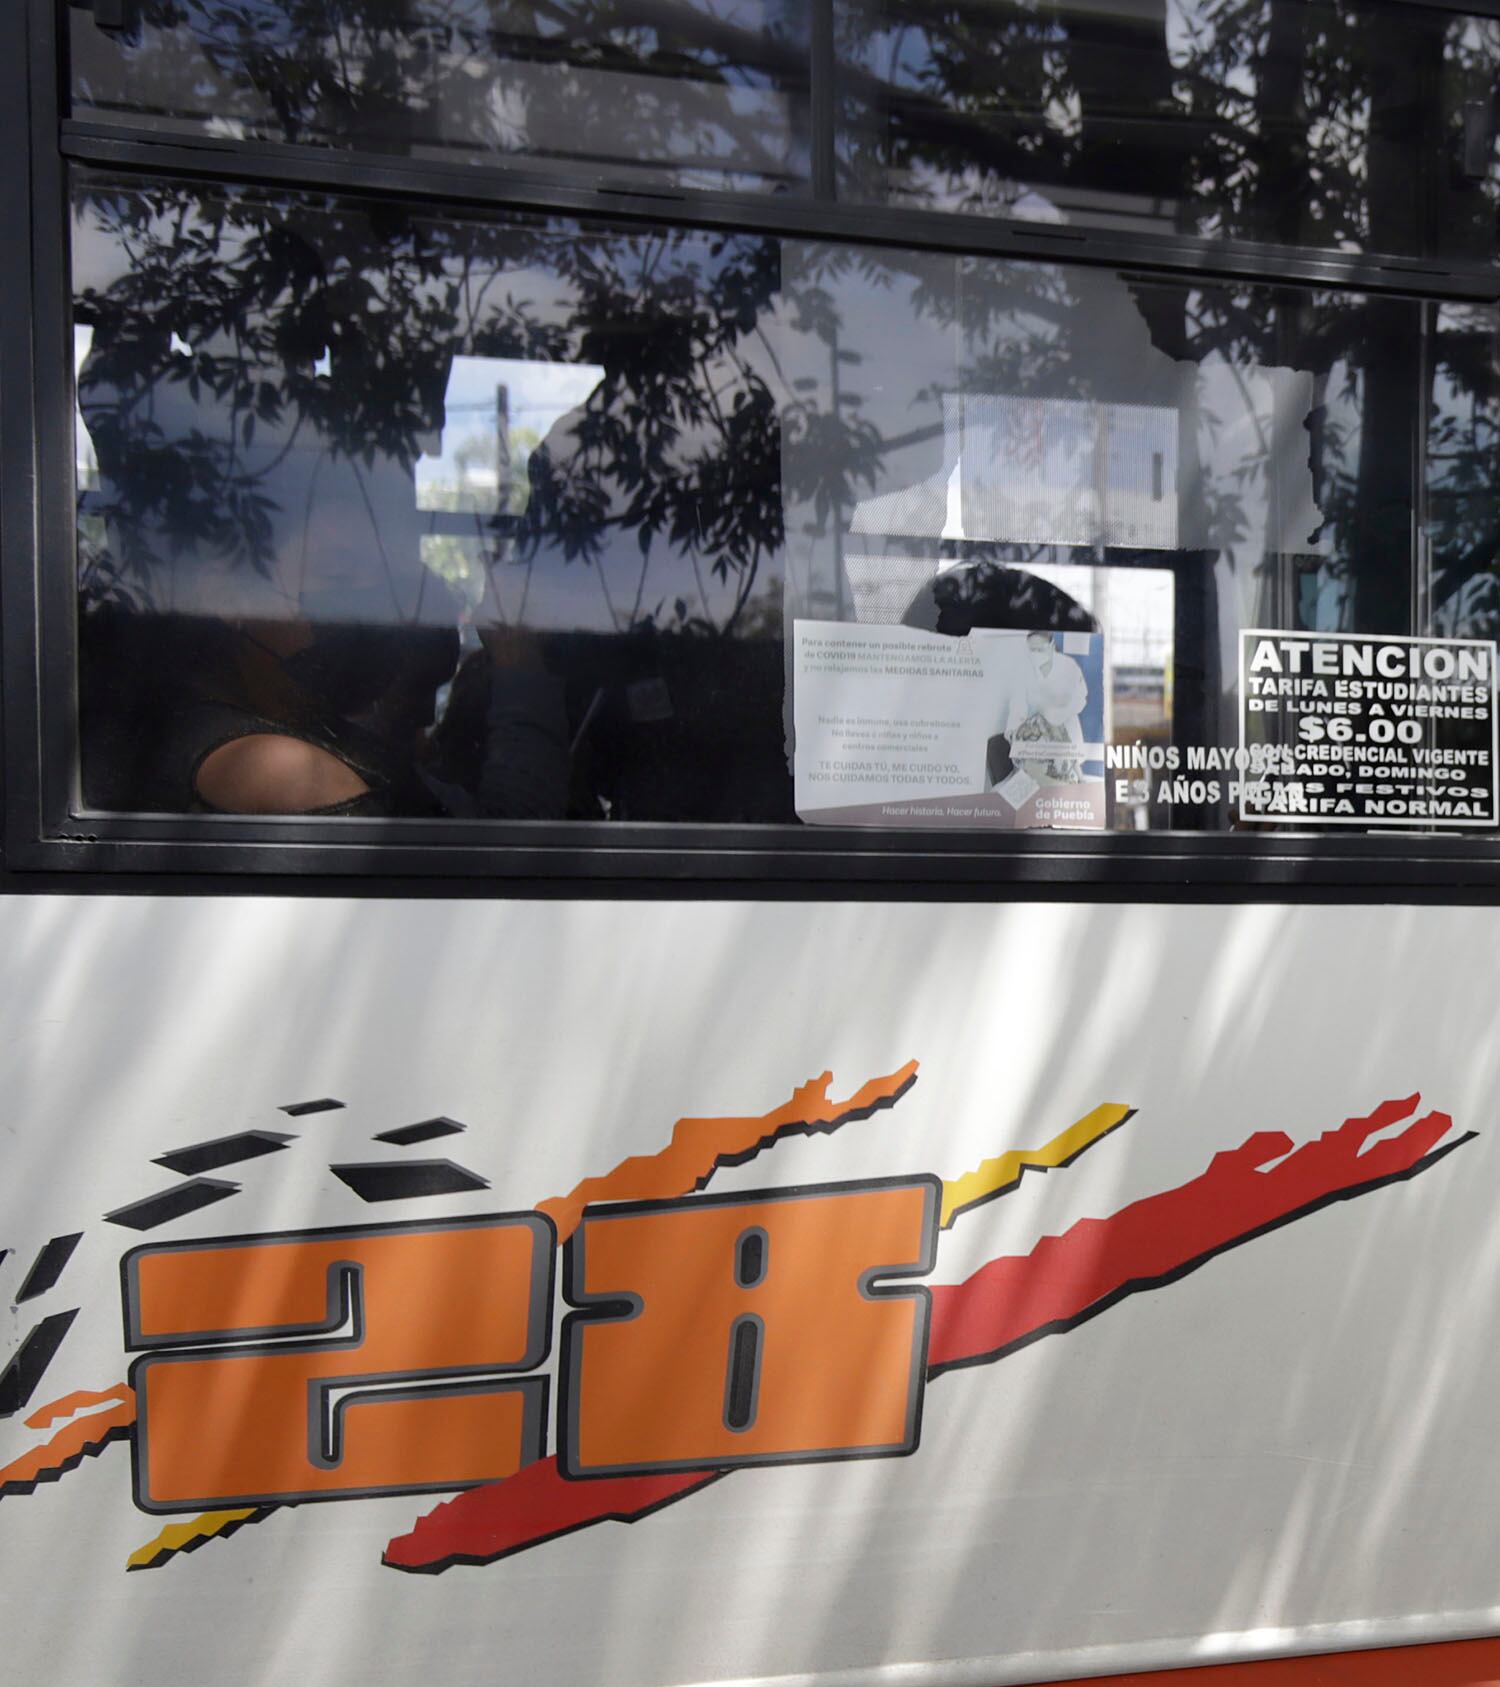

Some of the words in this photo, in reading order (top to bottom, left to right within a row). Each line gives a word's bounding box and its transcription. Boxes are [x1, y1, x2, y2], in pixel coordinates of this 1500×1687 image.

[882, 641, 916, 651] posible
[1250, 640, 1488, 681] ATENCION
[885, 666, 928, 676] MEDIDAS
[929, 668, 984, 678] SANITARIAS
[1249, 677, 1328, 697] TARIFA
[1335, 680, 1488, 703] ESTUDIANTES
[1248, 699, 1279, 712] DE
[1287, 701, 1362, 715] LUNES
[1369, 703, 1385, 716] A
[1391, 704, 1489, 719] VIERNES
[1298, 715, 1423, 744] $6.00
[1106, 740, 1180, 770] NIÑOS
[1294, 744, 1407, 764] CREDENCIAL
[1412, 749, 1489, 766] VIGENTE
[1359, 766, 1466, 781] DOMINGO
[1157, 775, 1221, 804] AÑOS
[1336, 783, 1489, 798] FESTIVOS
[881, 805, 909, 816] Hacer
[946, 807, 973, 817] Hacer
[1035, 798, 1091, 809] Gobierno
[1250, 798, 1355, 813] TARIFA
[1365, 801, 1489, 816] NORMAL
[1035, 810, 1051, 820] de
[1053, 810, 1095, 821] Puebla
[121, 1173, 943, 1515] 28
